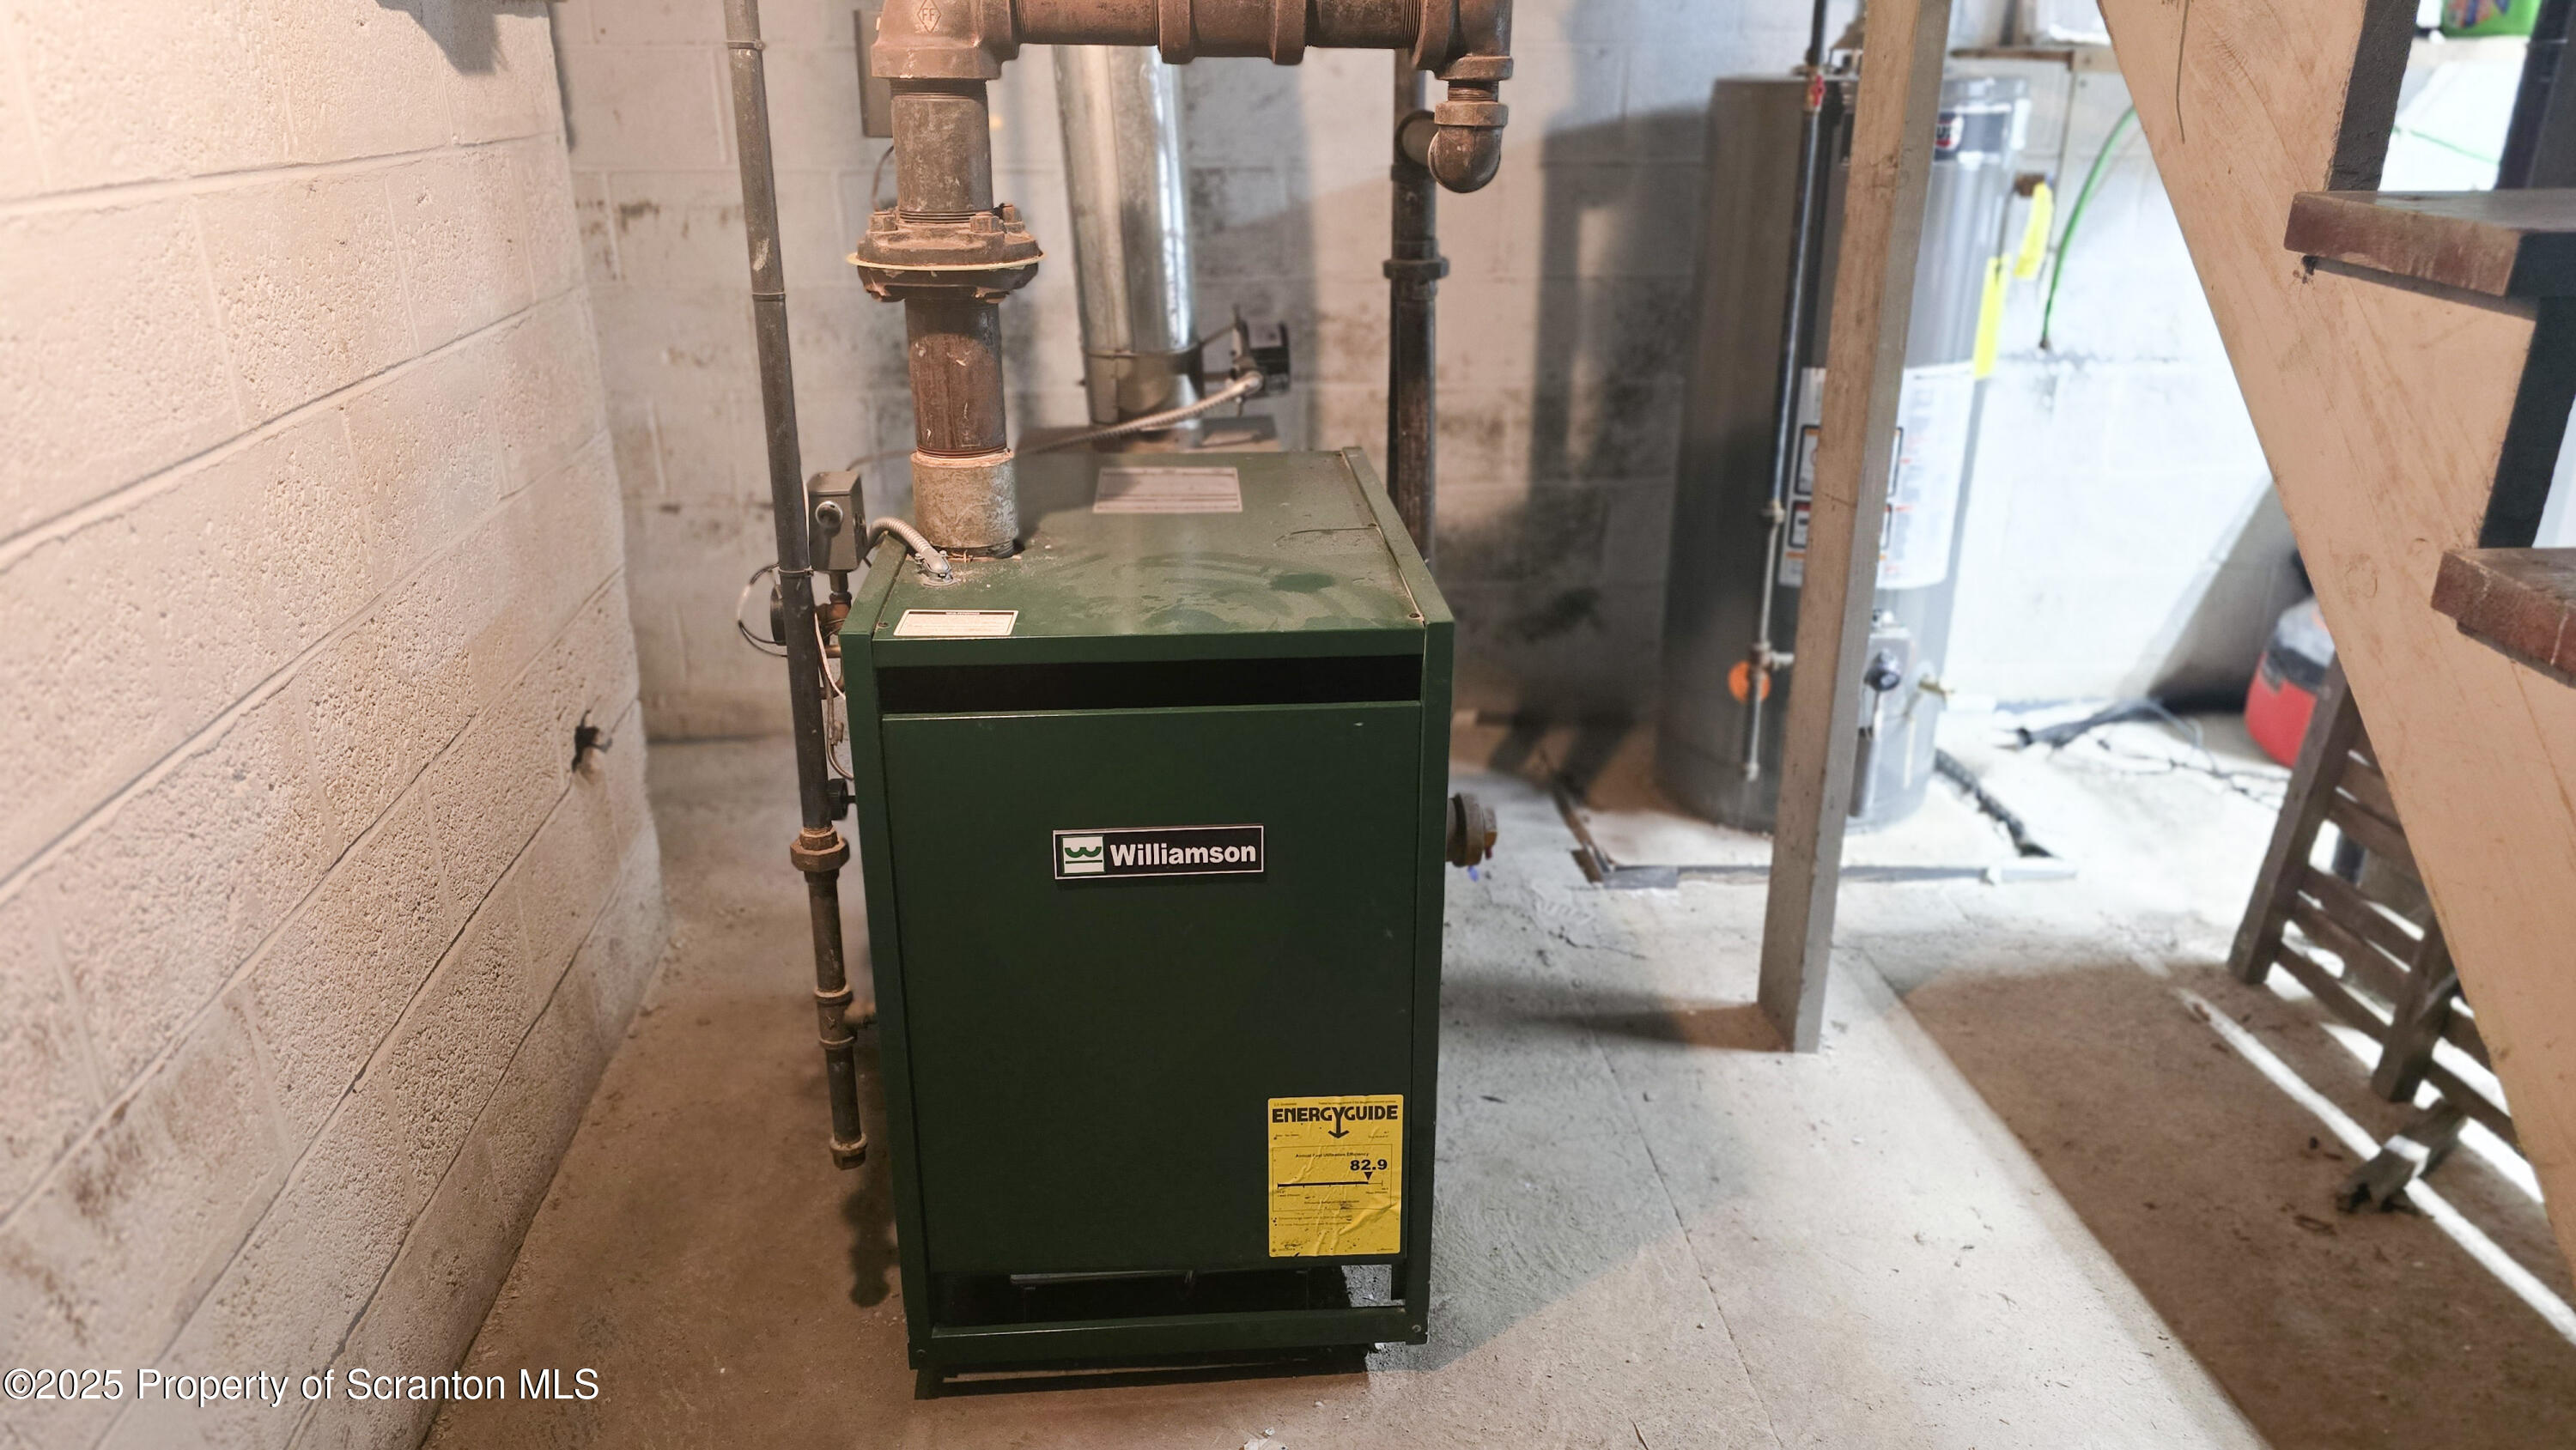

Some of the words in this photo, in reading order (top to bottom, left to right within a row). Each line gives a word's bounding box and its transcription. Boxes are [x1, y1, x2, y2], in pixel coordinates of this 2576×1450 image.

[921, 8, 936, 21] FF
[1110, 843, 1256, 866] Williamson
[1272, 1105, 1399, 1124] ENERGYGUIDE
[1350, 1159, 1388, 1171] 82.9
